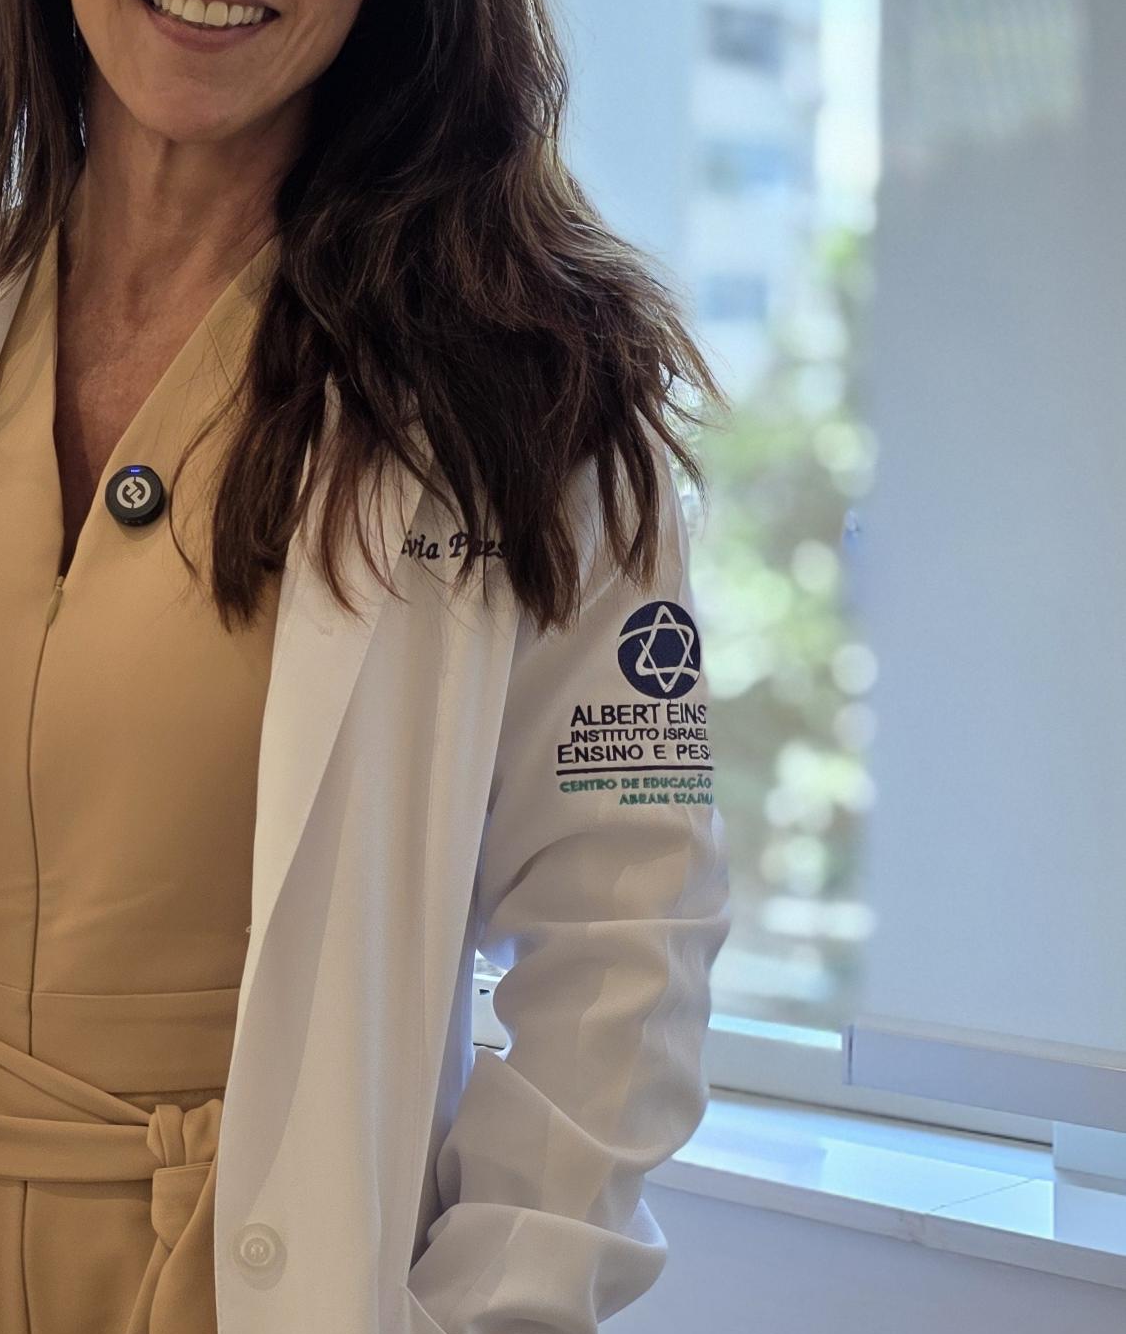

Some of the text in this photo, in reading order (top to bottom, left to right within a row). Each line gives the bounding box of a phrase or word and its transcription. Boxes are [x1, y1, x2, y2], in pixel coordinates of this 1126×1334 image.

[571, 702, 707, 727] ALBERT EINS
[571, 728, 659, 744] INSTITUTO
[558, 744, 643, 764] ENSINO
[654, 744, 666, 760] E
[559, 774, 712, 793] CENTRO DE EDUCAÇÃO
